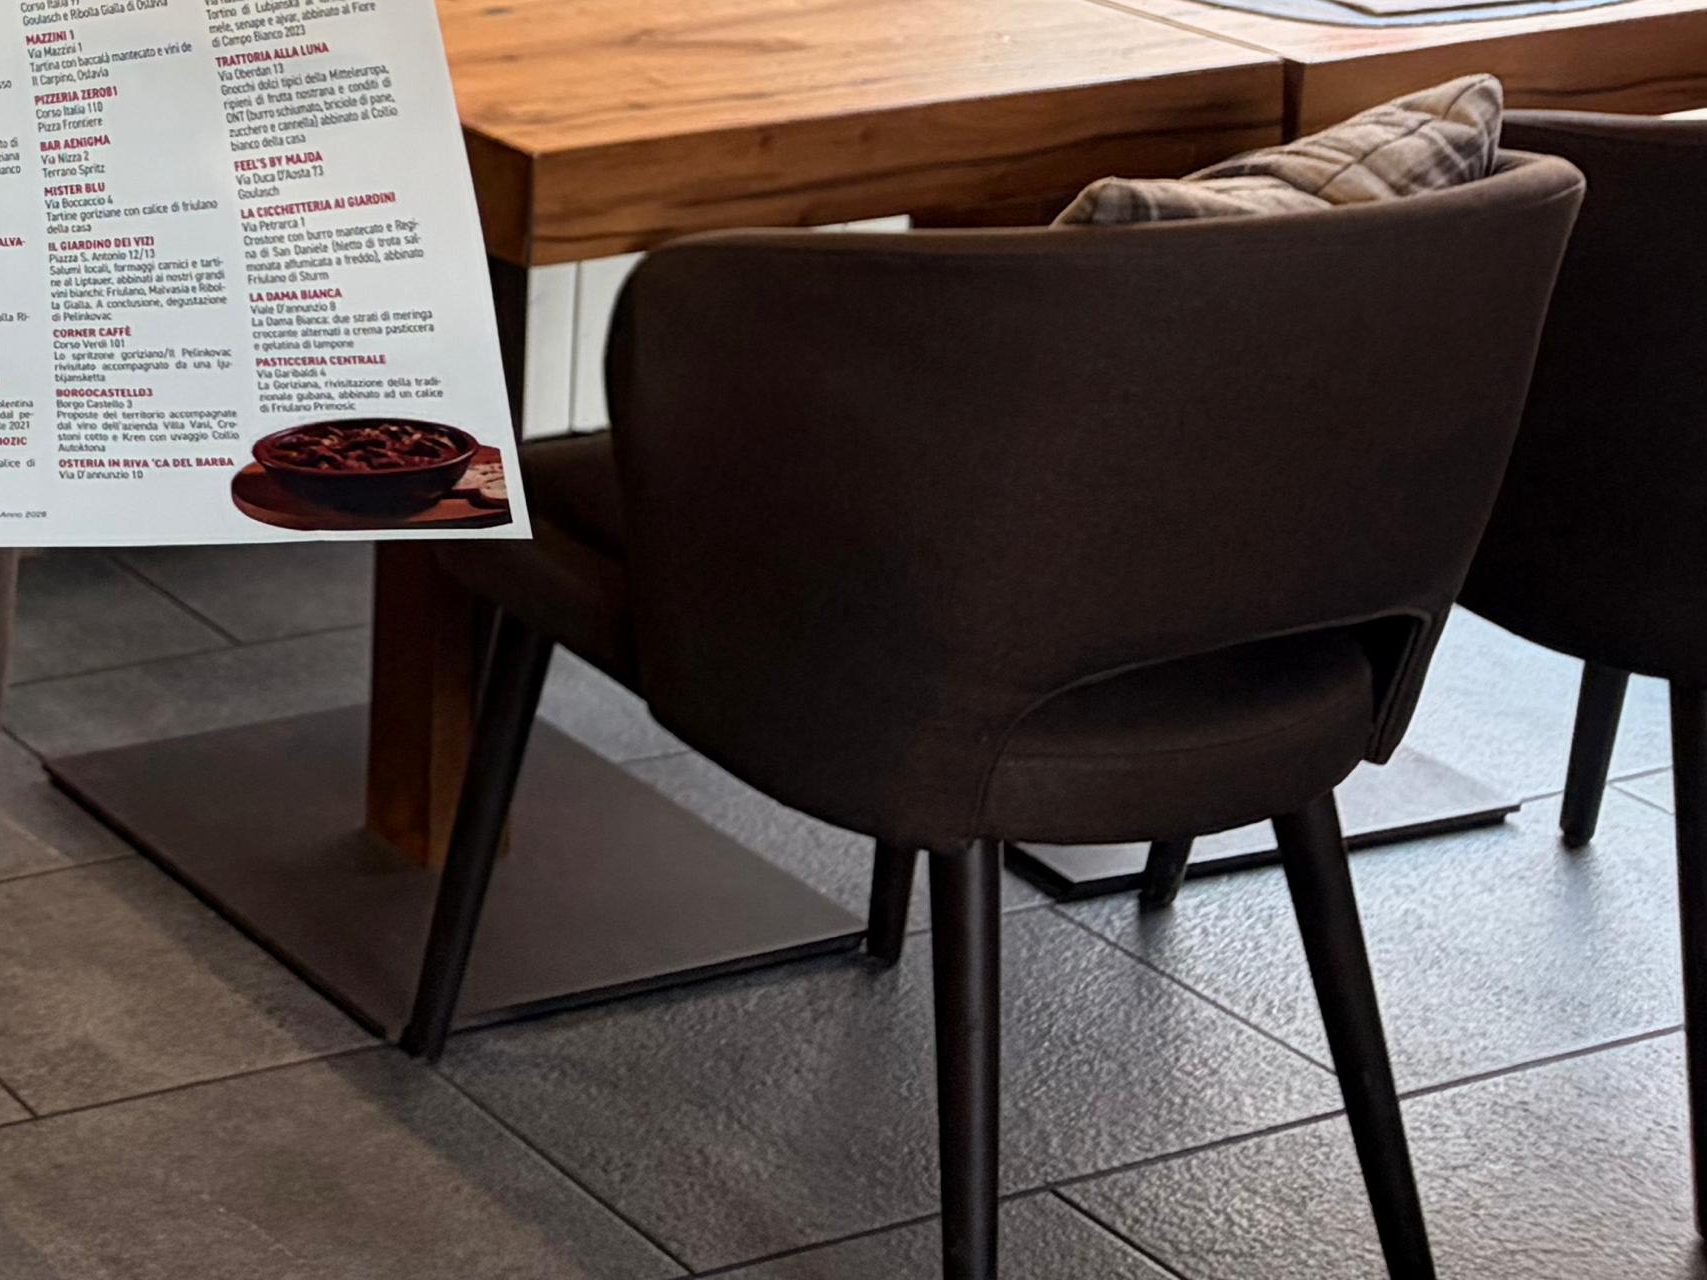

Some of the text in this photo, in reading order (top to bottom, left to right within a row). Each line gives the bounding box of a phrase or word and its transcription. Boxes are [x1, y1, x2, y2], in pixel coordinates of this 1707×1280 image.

[26, 30, 74, 45] MAZZINI 1
[216, 43, 329, 67] TRATTORIA ALLA LUNA
[35, 92, 79, 105] PIZZERIA
[41, 141, 61, 152] BAR
[269, 156, 282, 168] BY
[45, 183, 105, 196] MISTER BLU
[241, 193, 396, 219] LA CICCHETTERIA AI GIARDINI
[49, 237, 154, 251] IL GIARDINO DEI VIZI
[250, 289, 342, 302] LA DAMA BIANCA
[54, 327, 131, 338] CORNER CAFFÈ
[256, 355, 386, 367] PASTICCERIA CENTRALE
[59, 460, 105, 468] OSTERIA
[124, 460, 149, 468] RIVA
[173, 459, 193, 468] DEL
[196, 458, 234, 467] BARBA
